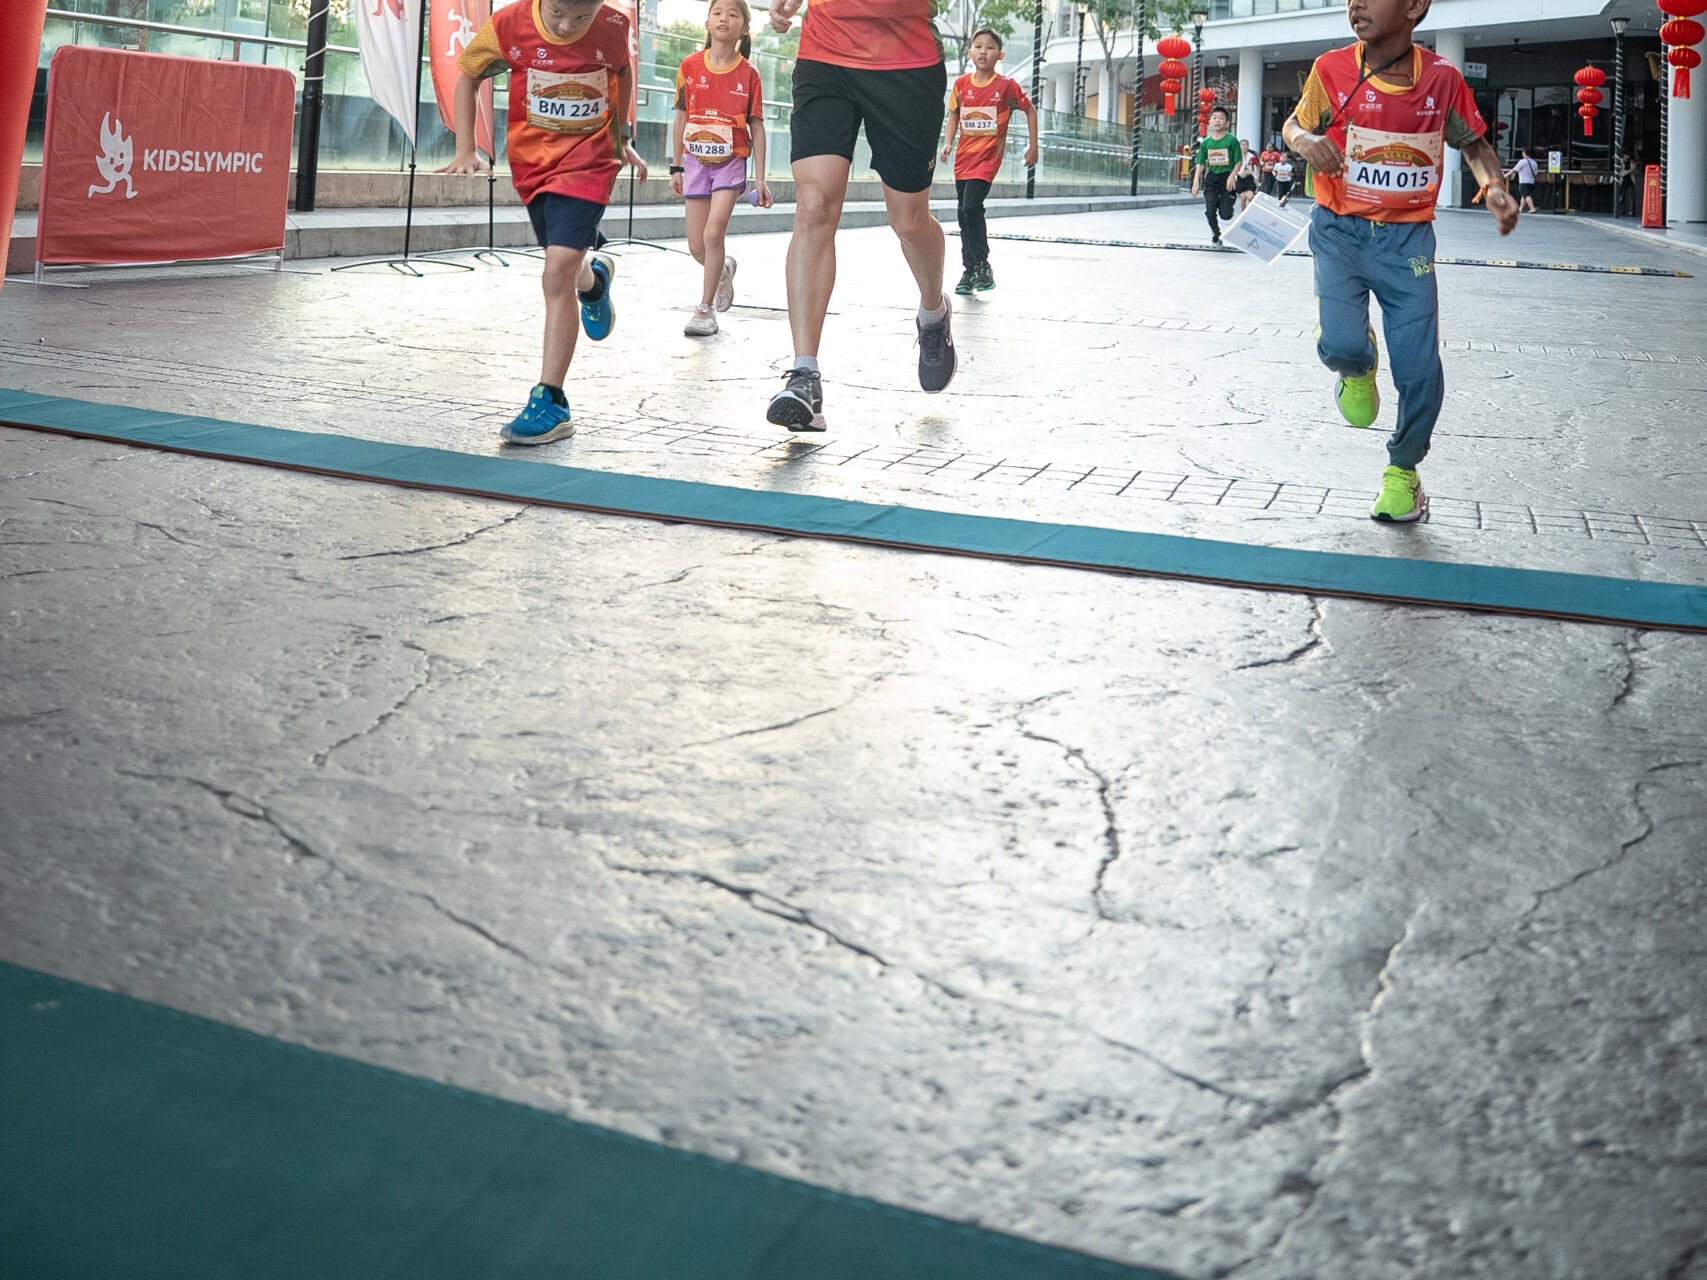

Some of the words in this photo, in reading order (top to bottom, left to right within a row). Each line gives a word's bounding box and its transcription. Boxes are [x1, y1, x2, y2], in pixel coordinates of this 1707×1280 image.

[539, 100, 565, 116] BM
[570, 101, 600, 117] 224
[689, 143, 703, 153] BM
[705, 145, 725, 155] 288
[143, 148, 263, 173] KIDSLYMPIC
[1356, 166, 1391, 187] AM
[1396, 170, 1429, 188] 015
